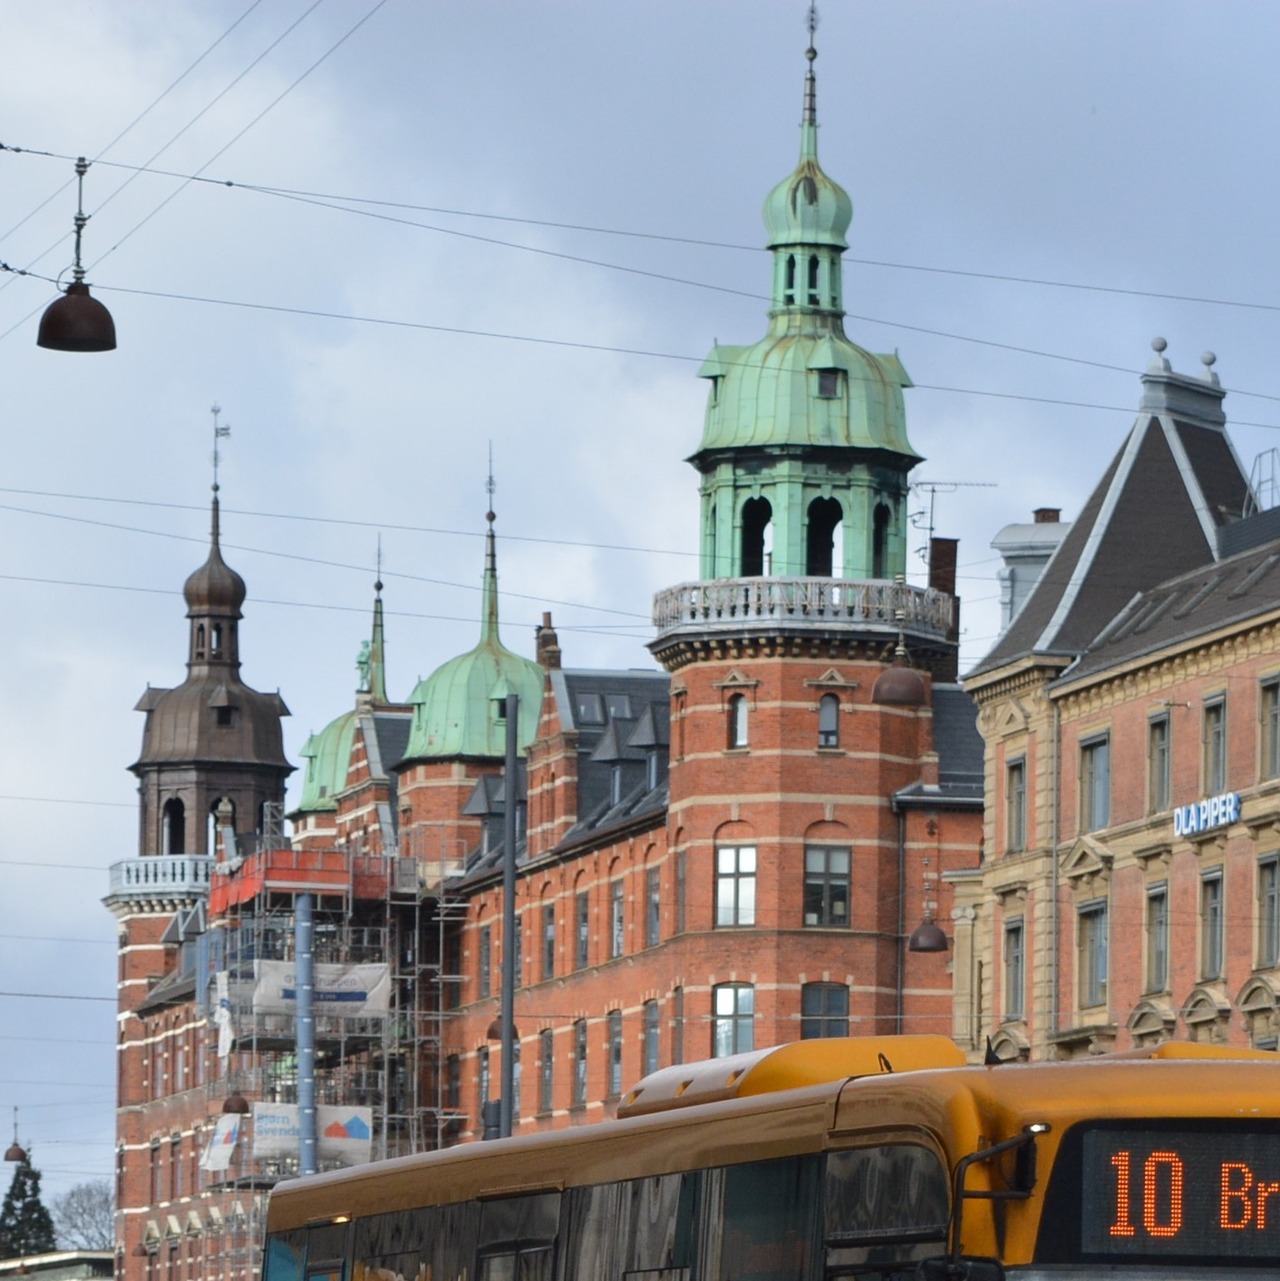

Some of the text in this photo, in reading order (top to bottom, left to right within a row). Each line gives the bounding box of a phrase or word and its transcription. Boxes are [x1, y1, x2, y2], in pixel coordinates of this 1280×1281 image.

[1174, 792, 1235, 837] DLA PIPER
[1109, 1150, 1184, 1238] 10
